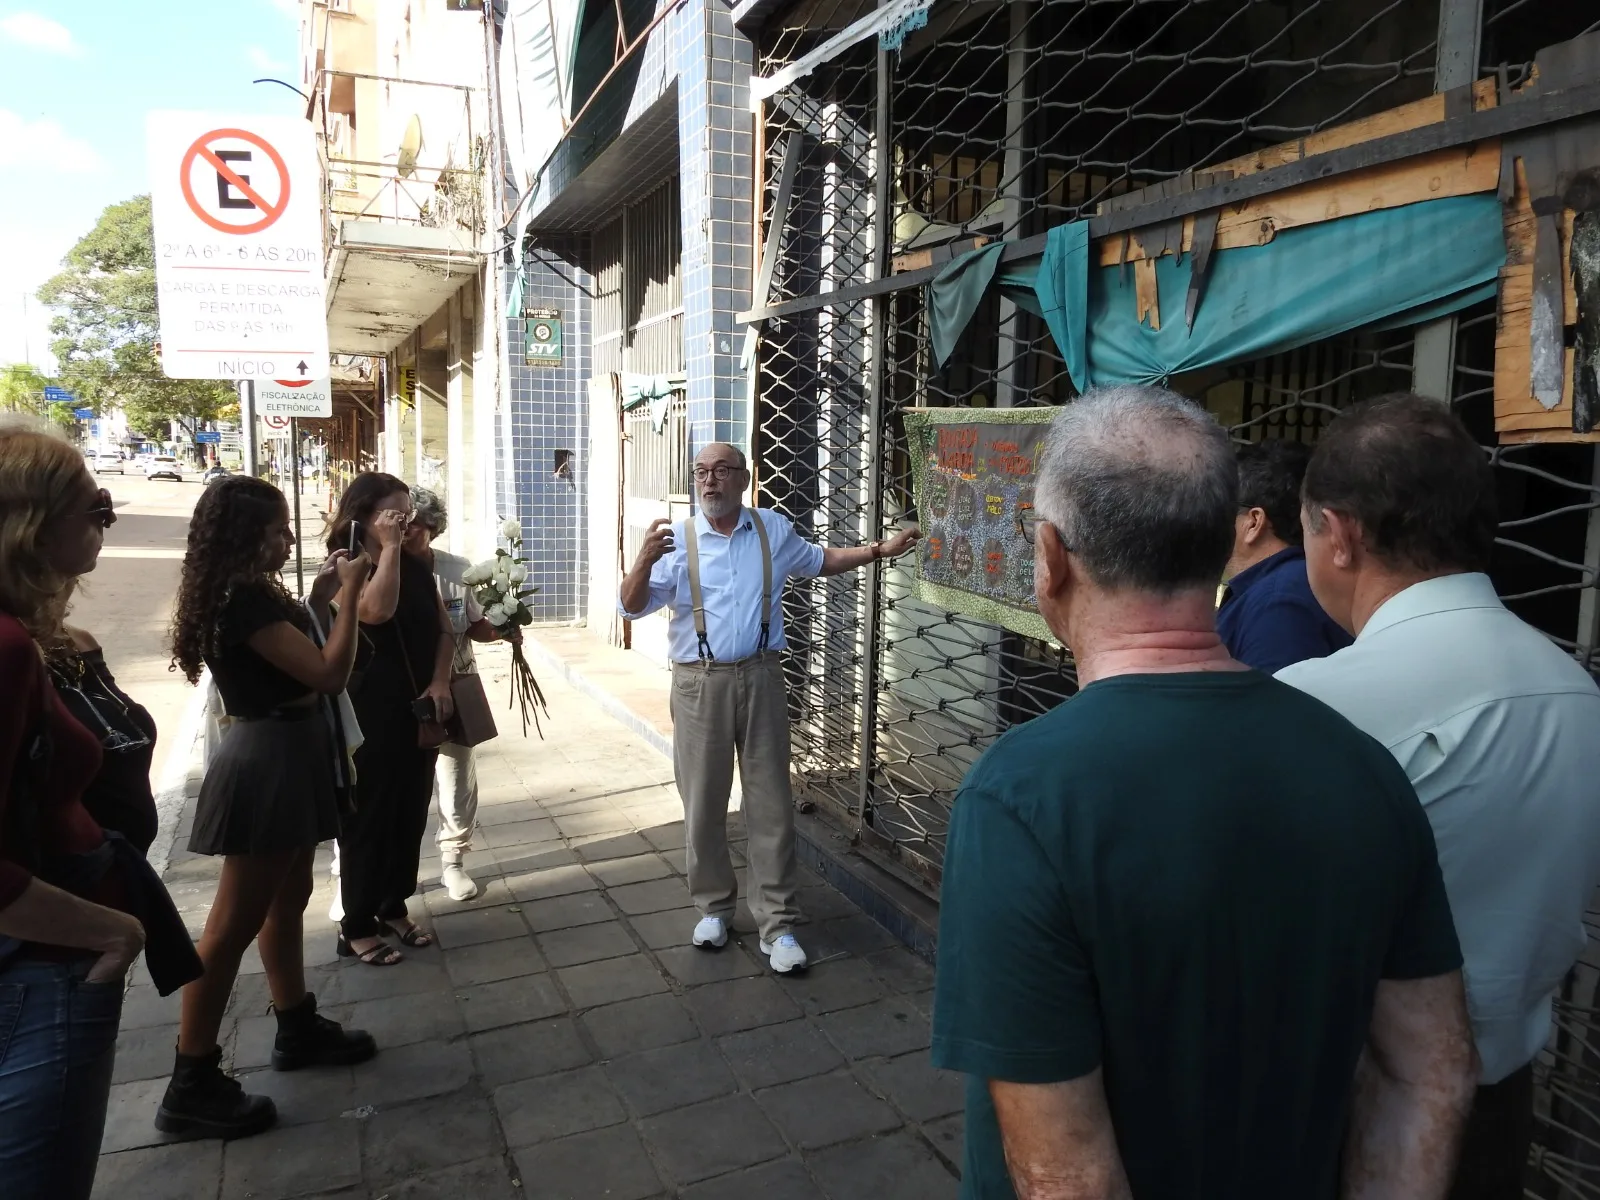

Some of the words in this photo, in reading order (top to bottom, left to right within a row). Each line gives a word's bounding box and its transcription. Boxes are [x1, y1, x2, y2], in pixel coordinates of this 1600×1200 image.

[185, 244, 197, 259] A
[286, 247, 316, 262] 20h
[161, 281, 217, 294] CARGA
[221, 283, 230, 295] E
[236, 284, 321, 297] DESCARGA
[199, 301, 283, 315] PERMITIDA
[194, 320, 226, 332] DAS
[527, 343, 558, 354] STV
[217, 357, 275, 375] INÍCIO
[261, 391, 326, 402] FISCALIZAÇÃO
[266, 402, 321, 412] ELETRÔNICA
